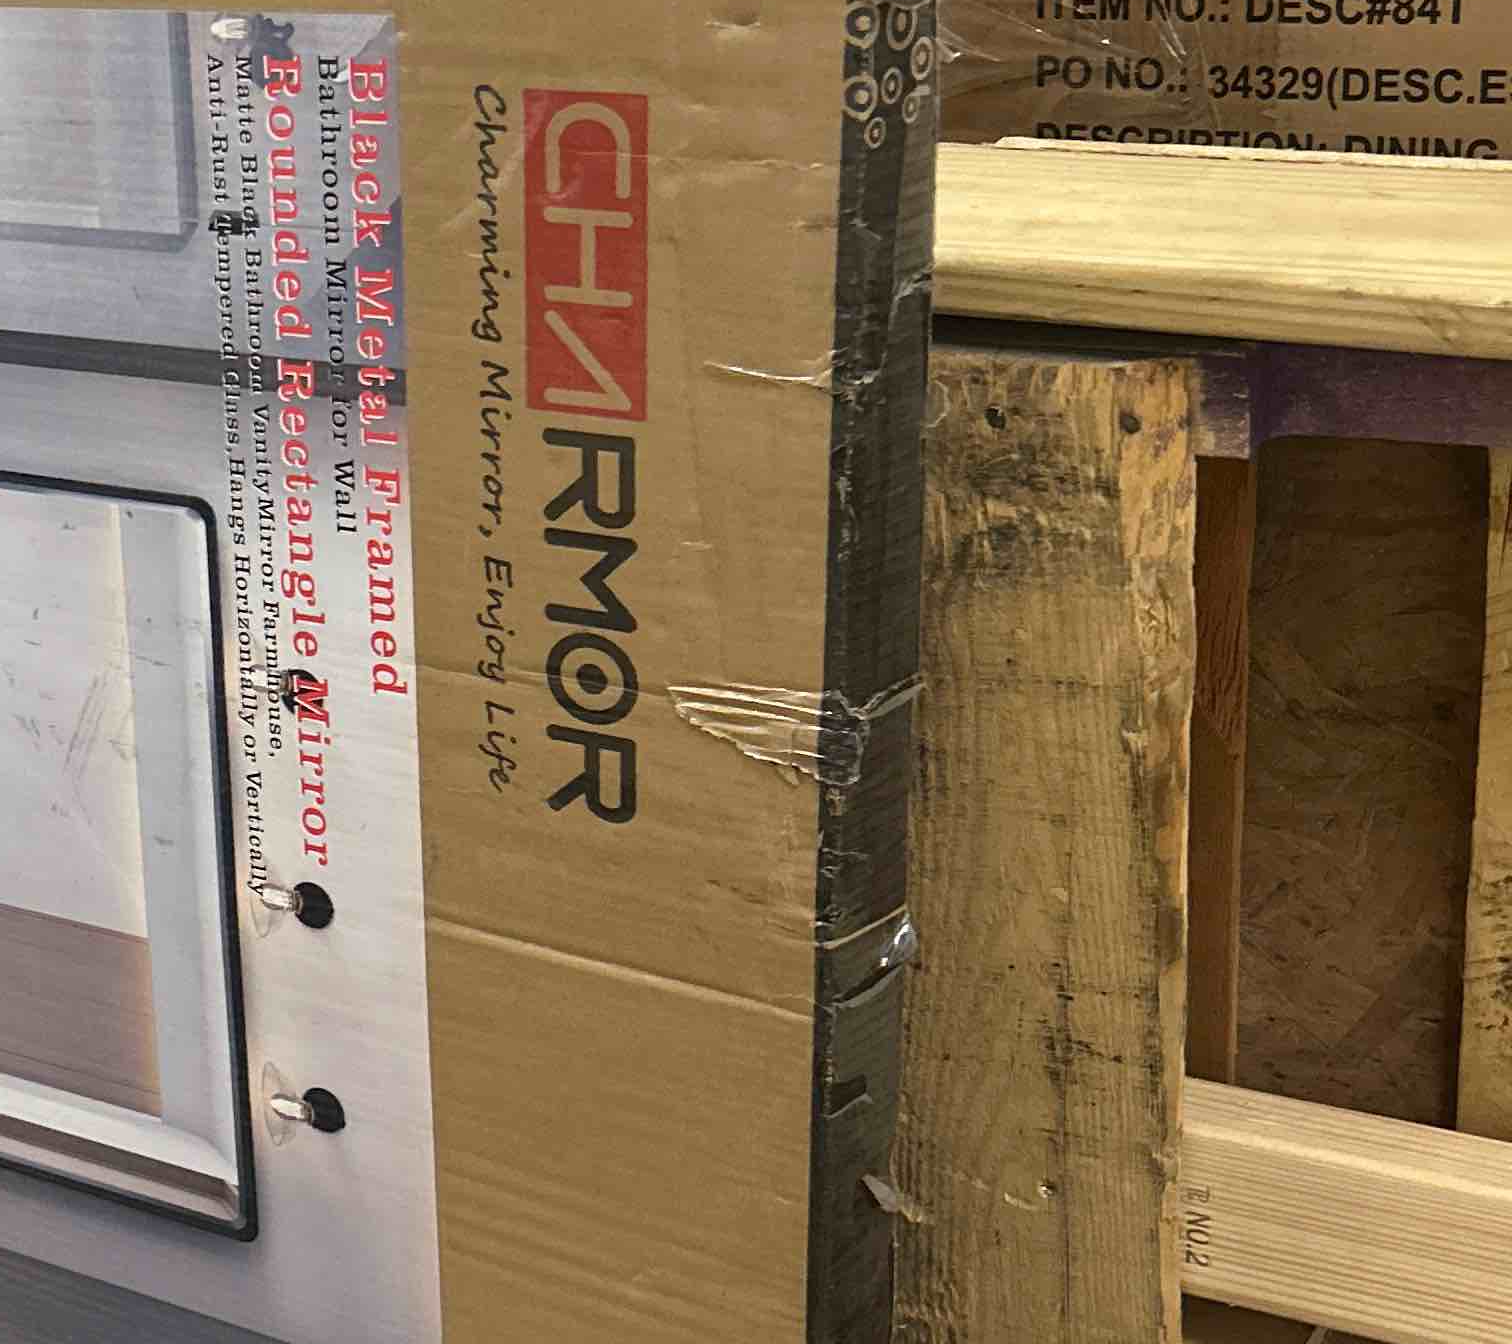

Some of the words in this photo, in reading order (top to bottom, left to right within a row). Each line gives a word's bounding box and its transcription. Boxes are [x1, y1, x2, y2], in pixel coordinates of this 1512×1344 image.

[208, 55, 230, 203] Anti-Rust
[235, 55, 253, 144] Matte
[1037, 55, 1091, 90] PO
[240, 154, 260, 241] Black
[264, 55, 313, 341] Rounded
[317, 56, 342, 246] Bathroom
[347, 58, 393, 248] Black
[472, 84, 514, 345] Charming
[214, 212, 239, 361] Tempered
[243, 248, 265, 395] Bathroom
[325, 258, 349, 386] Mirror
[354, 266, 399, 446] Metal
[329, 396, 352, 447] for
[478, 359, 512, 538] Mirror,
[542, 102, 638, 825] CHARMOR
[276, 358, 326, 658] Rectangle
[334, 459, 358, 534] Wall
[235, 554, 257, 730] Horizontally
[363, 464, 407, 696] Framed
[476, 556, 514, 685] Enjoy
[244, 735, 259, 764] or
[293, 675, 331, 867] Mirror
[482, 702, 514, 794] Life
[245, 771, 266, 897] Vertically
